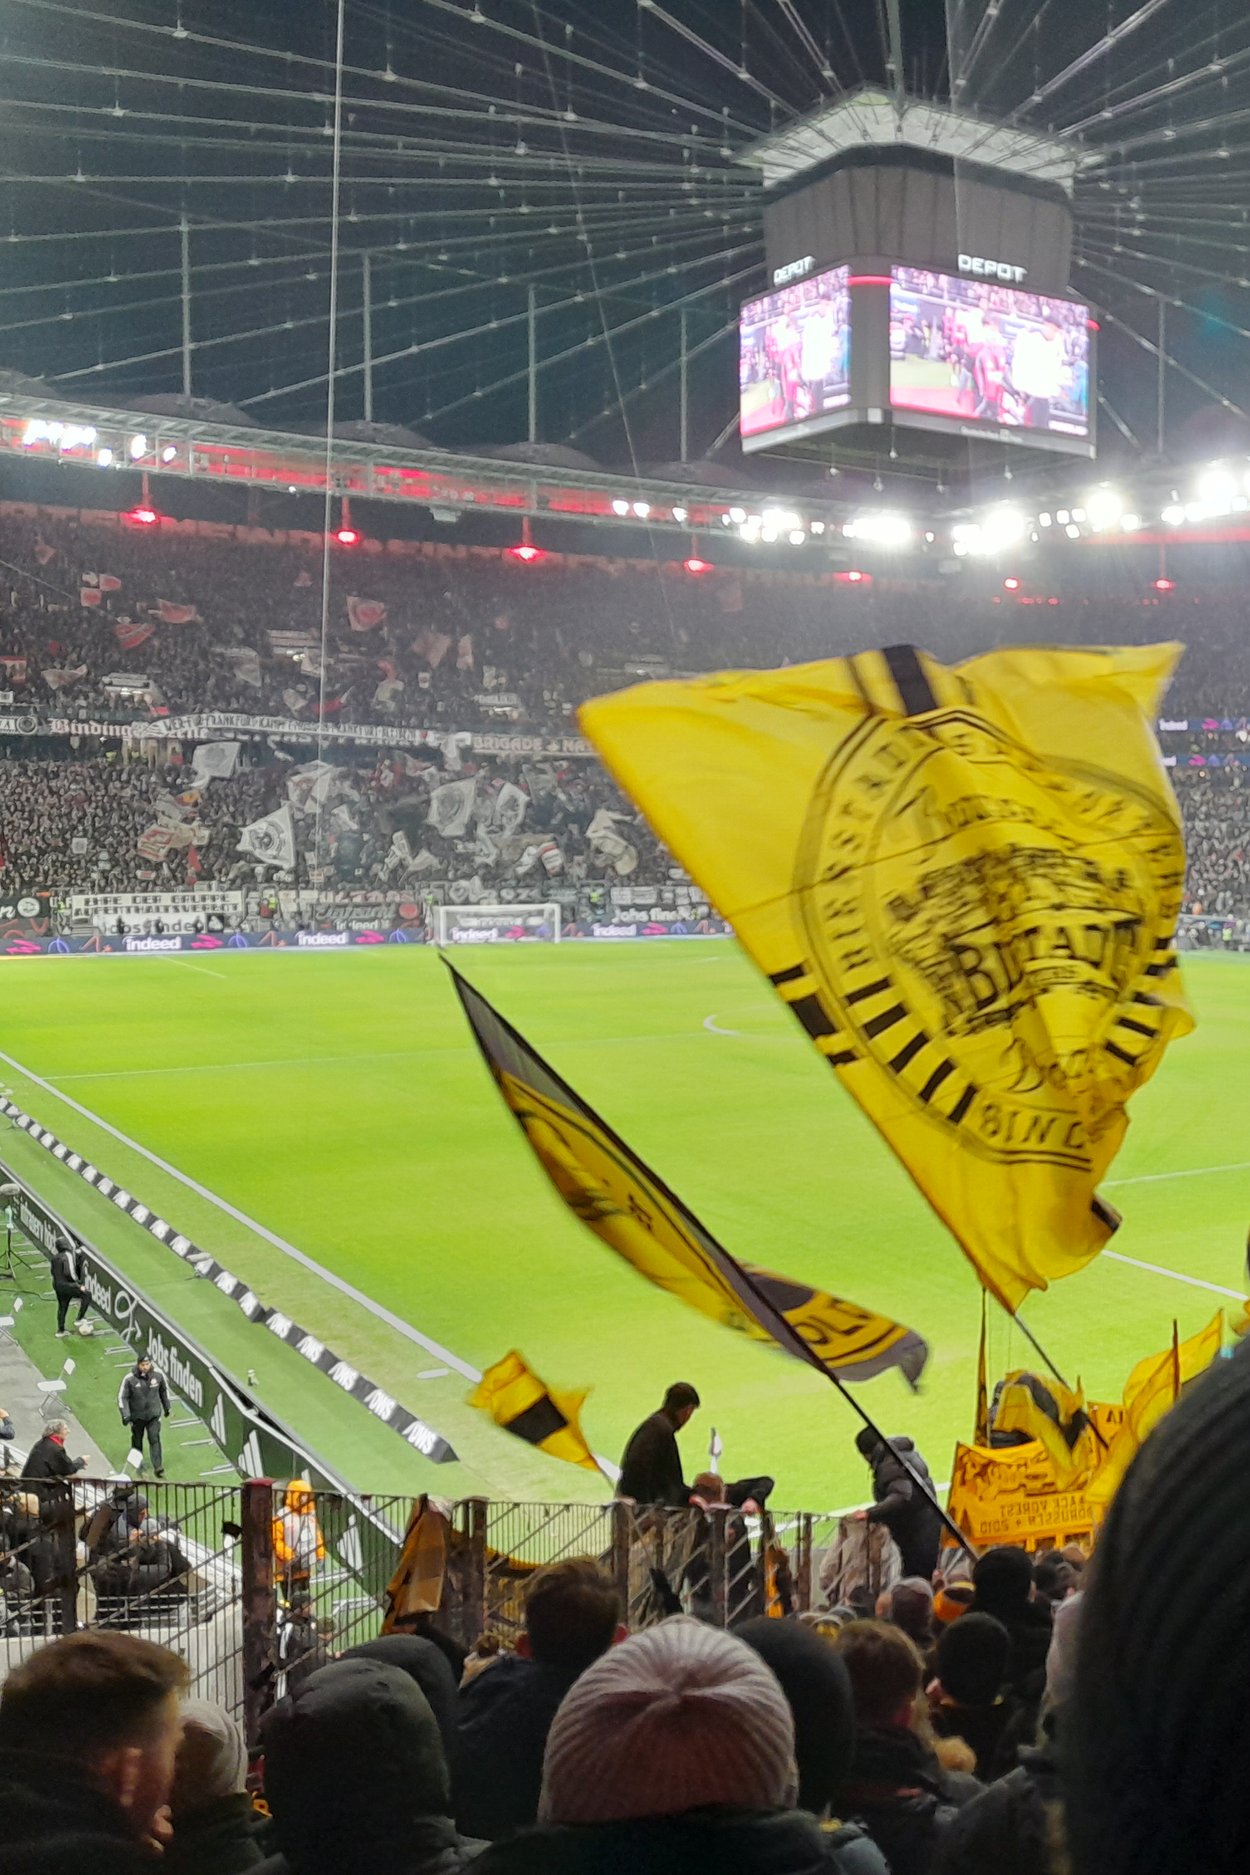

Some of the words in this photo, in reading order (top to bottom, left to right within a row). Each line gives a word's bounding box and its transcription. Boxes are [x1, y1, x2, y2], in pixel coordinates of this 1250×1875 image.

[774, 255, 816, 284] DEPOT
[958, 254, 1028, 284] DEPOT
[473, 735, 543, 751] BRIGADE
[296, 930, 350, 946] indeed
[592, 923, 637, 937] indeed
[123, 936, 181, 951] indeed
[84, 1260, 111, 1315] indeed
[147, 1326, 169, 1373] Jobs
[170, 1346, 203, 1407] finden
